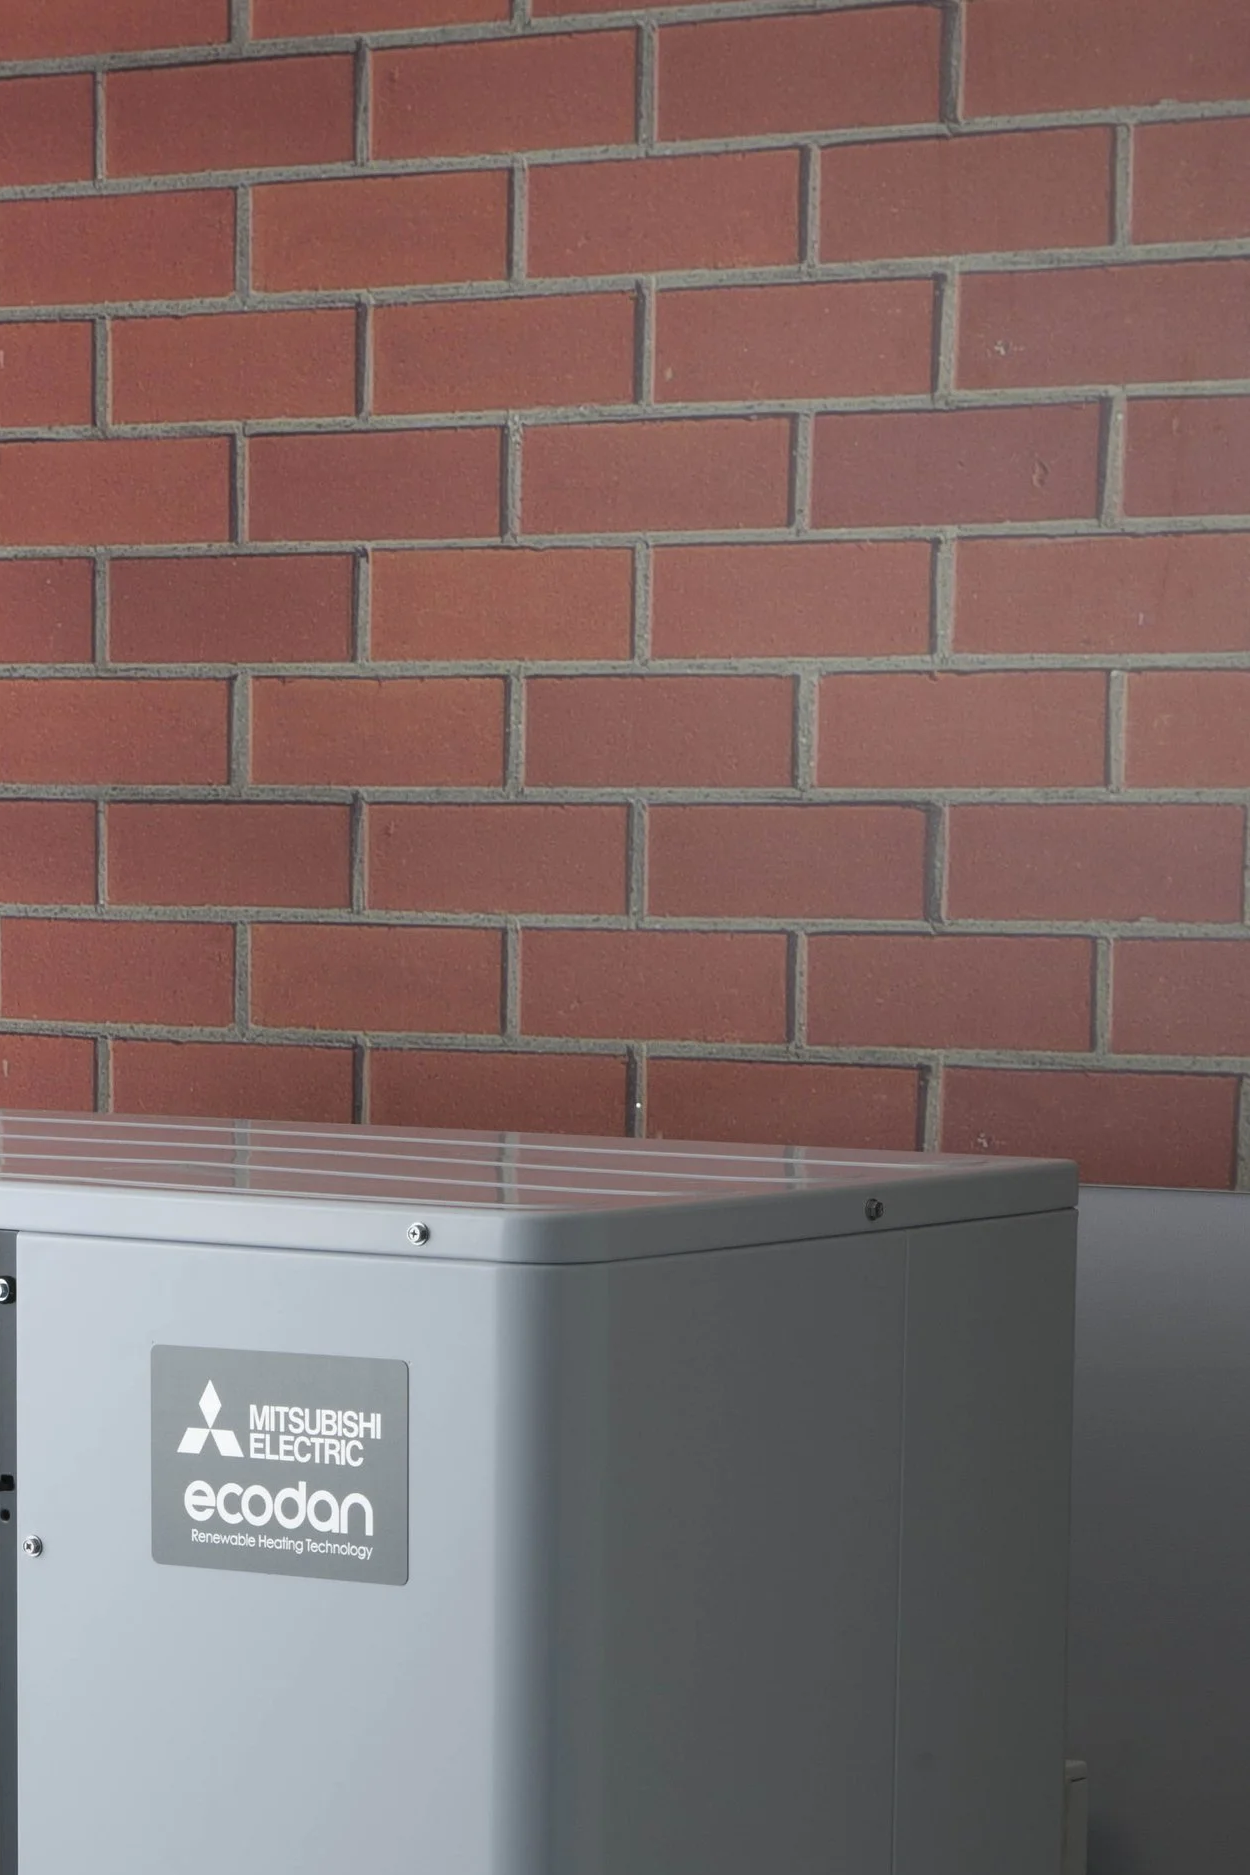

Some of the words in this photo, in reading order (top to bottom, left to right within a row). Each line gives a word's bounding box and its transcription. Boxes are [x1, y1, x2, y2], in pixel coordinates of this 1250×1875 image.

[250, 1404, 381, 1439] MITSUBISHI
[250, 1433, 364, 1466] ELECTRIC
[184, 1480, 373, 1536] ecodan
[191, 1528, 256, 1548] Renewable
[258, 1535, 303, 1554] Heating
[306, 1538, 373, 1559] Technology
